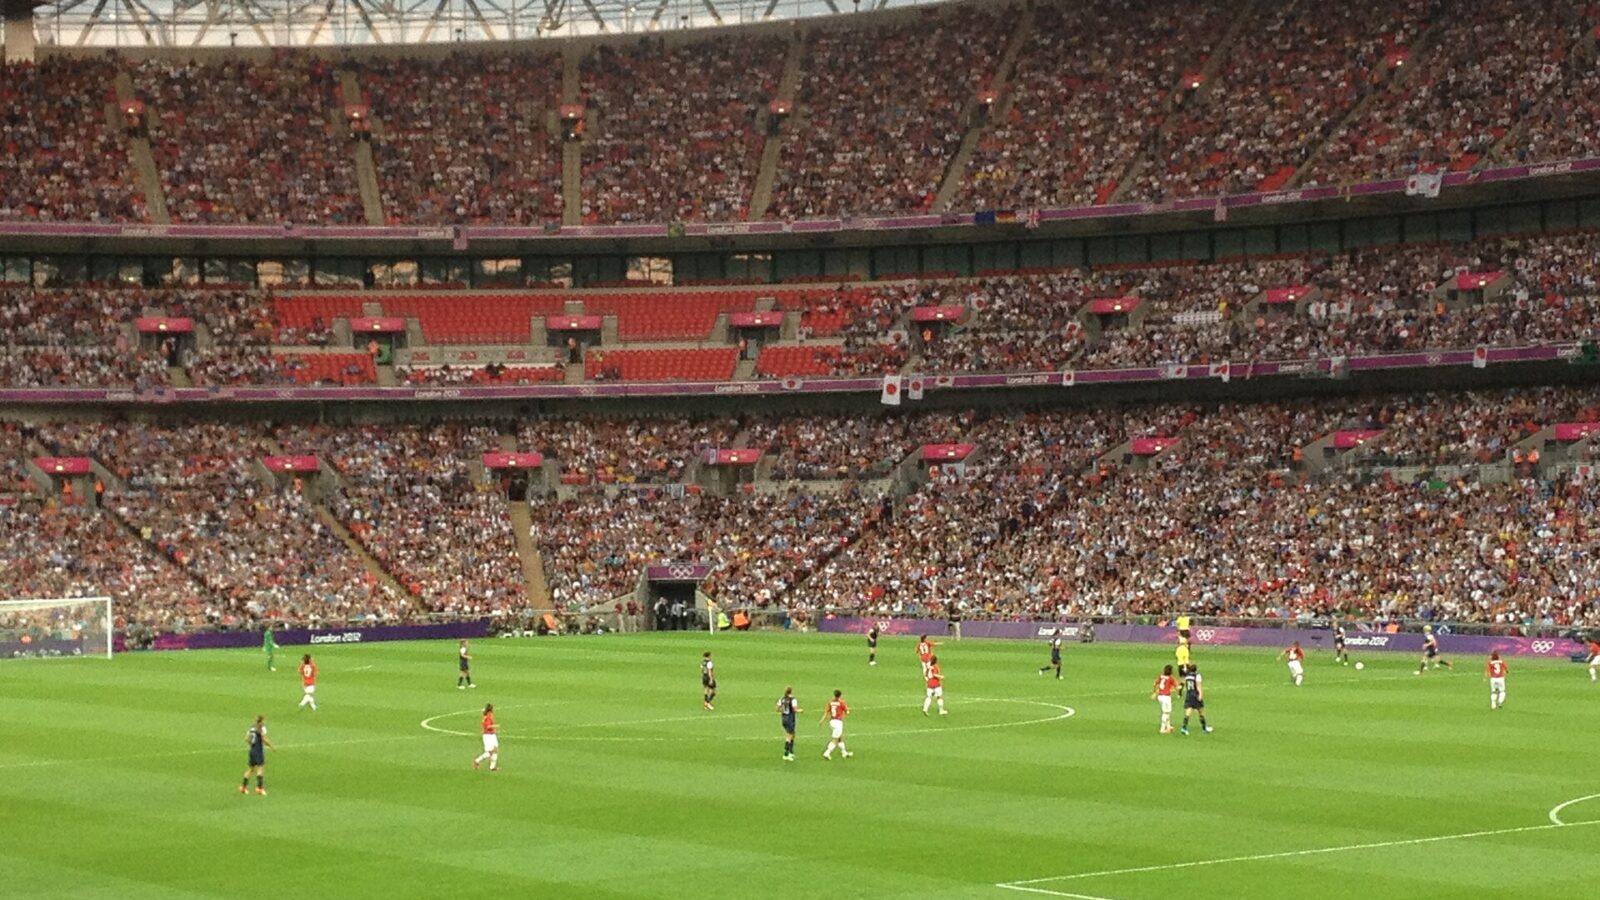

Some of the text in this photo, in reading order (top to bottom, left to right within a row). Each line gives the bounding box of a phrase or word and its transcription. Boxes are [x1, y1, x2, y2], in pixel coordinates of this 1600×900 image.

[1006, 376, 1031, 385] London
[415, 389, 442, 399] London
[715, 385, 741, 393] London
[310, 632, 361, 643] London 2012
[1344, 636, 1388, 646] ondon 2012
